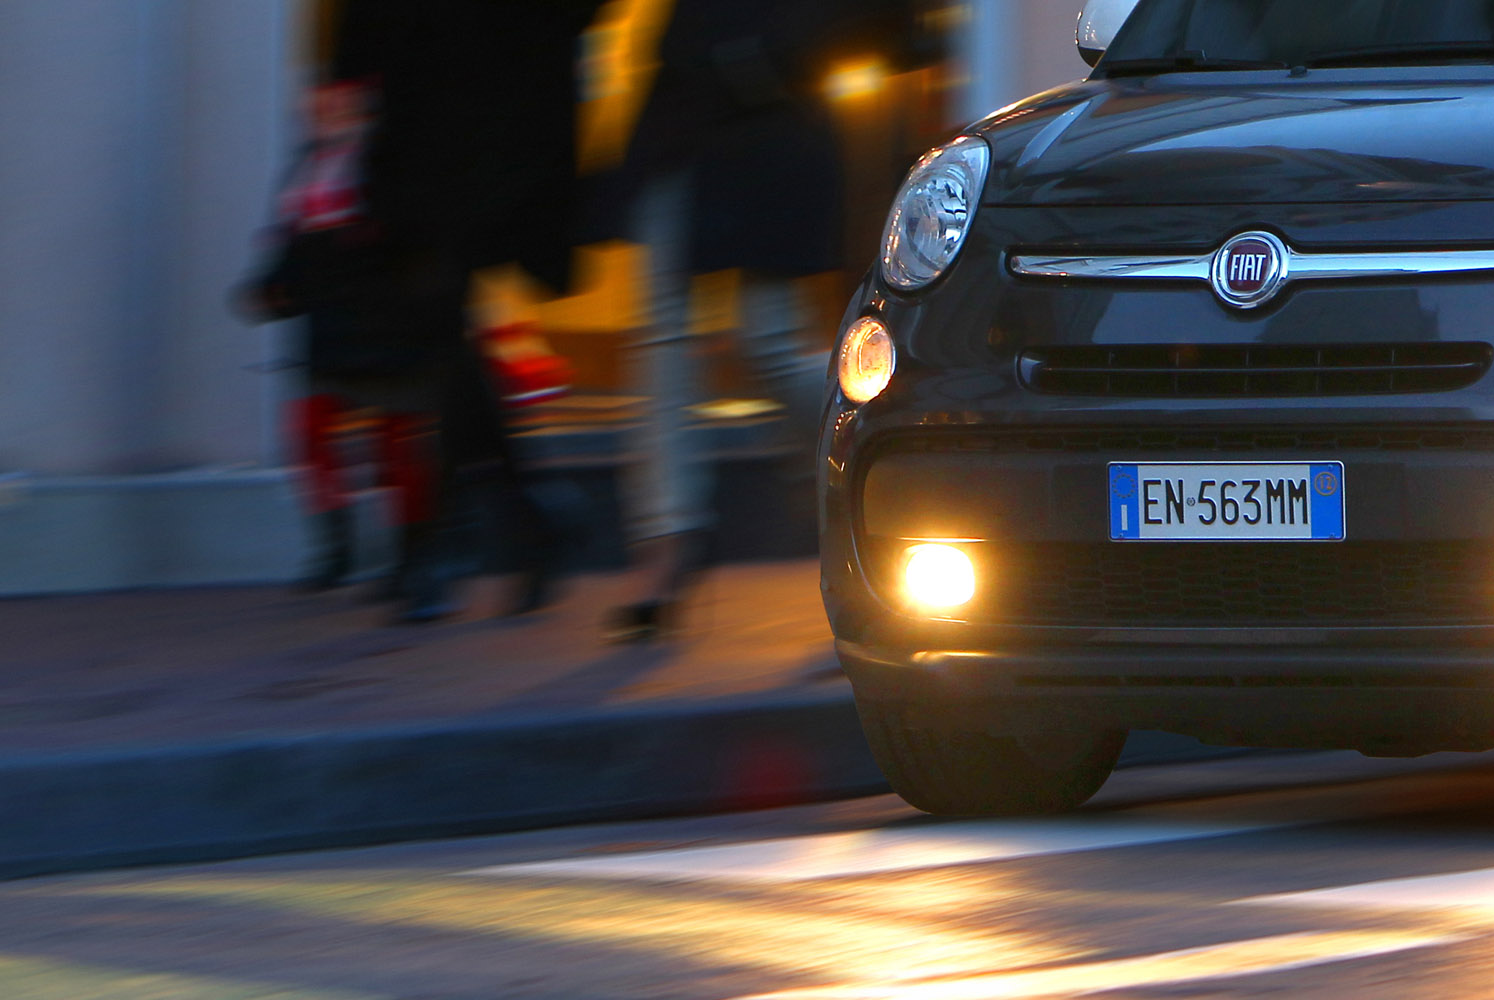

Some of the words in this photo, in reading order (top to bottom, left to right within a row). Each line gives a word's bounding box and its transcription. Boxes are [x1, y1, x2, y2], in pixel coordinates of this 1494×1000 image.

[1230, 254, 1267, 281] FIAT
[1143, 479, 1185, 525] EN
[1198, 479, 1309, 526] 563MM
